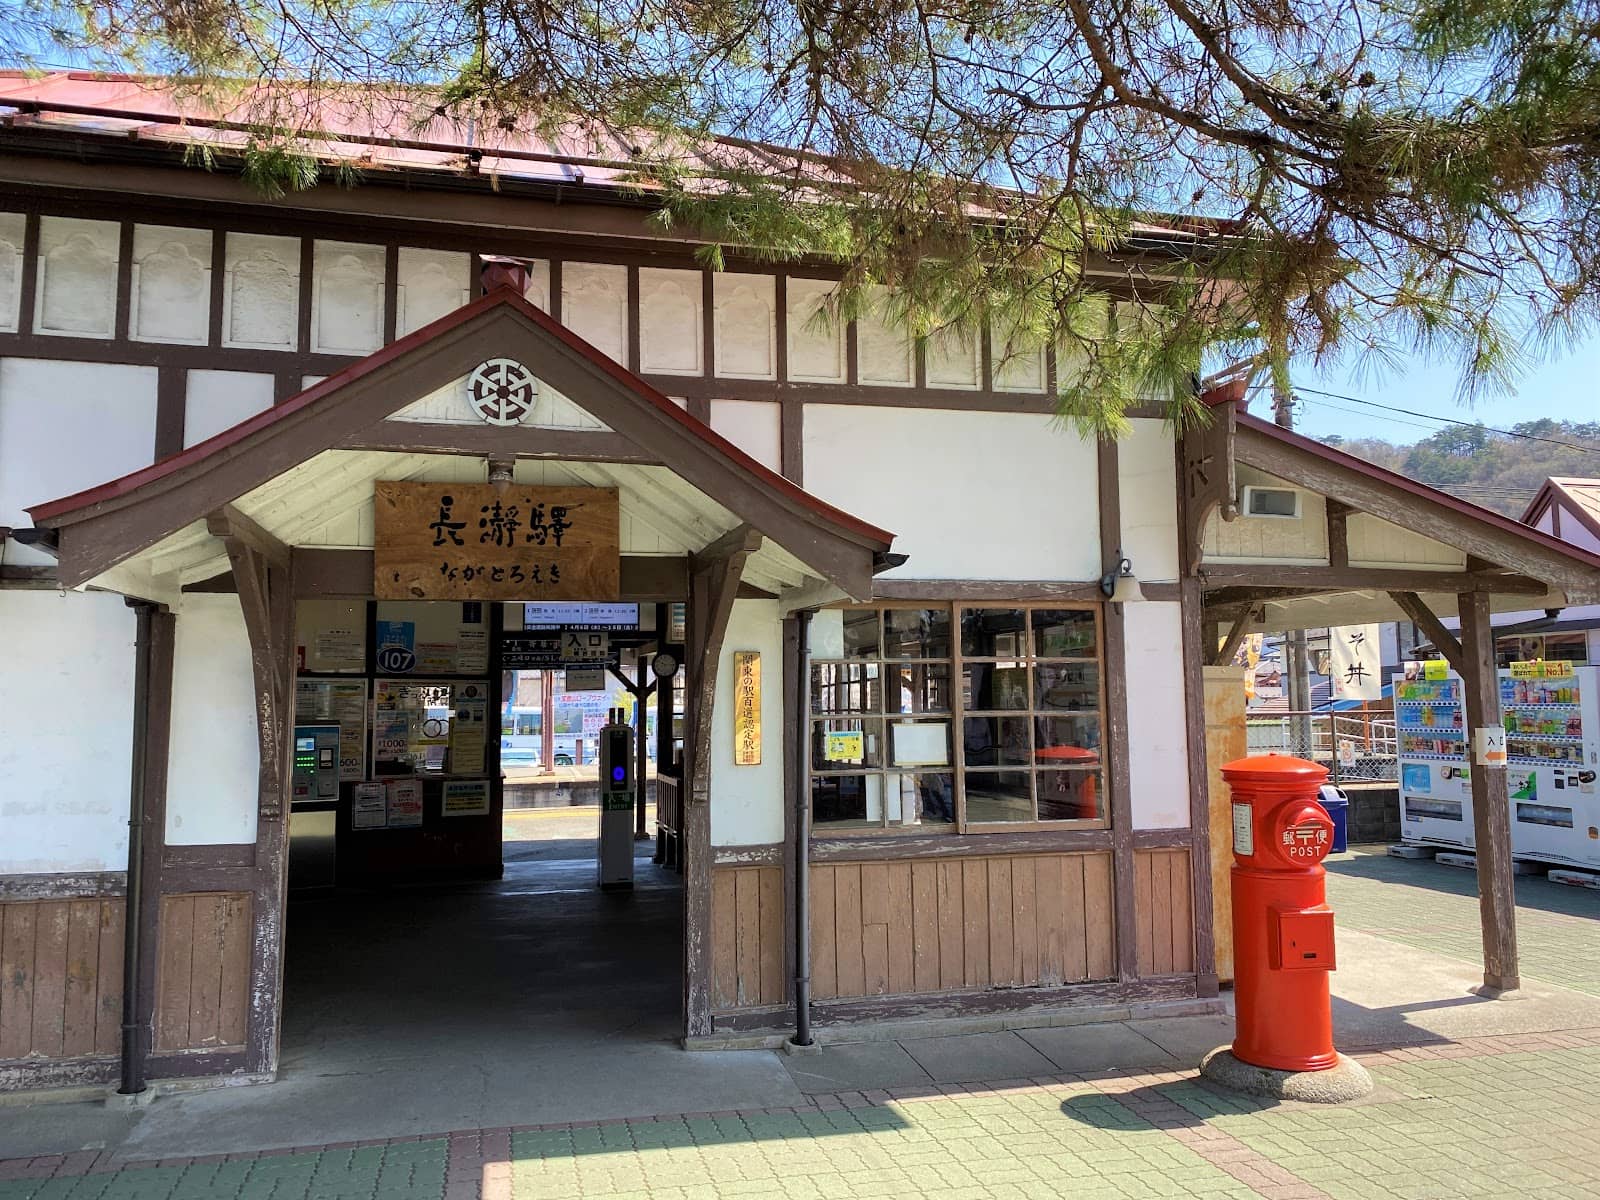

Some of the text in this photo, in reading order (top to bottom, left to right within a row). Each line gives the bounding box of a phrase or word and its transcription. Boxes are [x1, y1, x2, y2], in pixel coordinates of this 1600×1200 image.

[440, 561, 562, 584] ながとろえき
[568, 634, 601, 646] 入口
[384, 651, 412, 668] 107
[1545, 662, 1564, 676] No.1
[1290, 846, 1321, 857] POST
